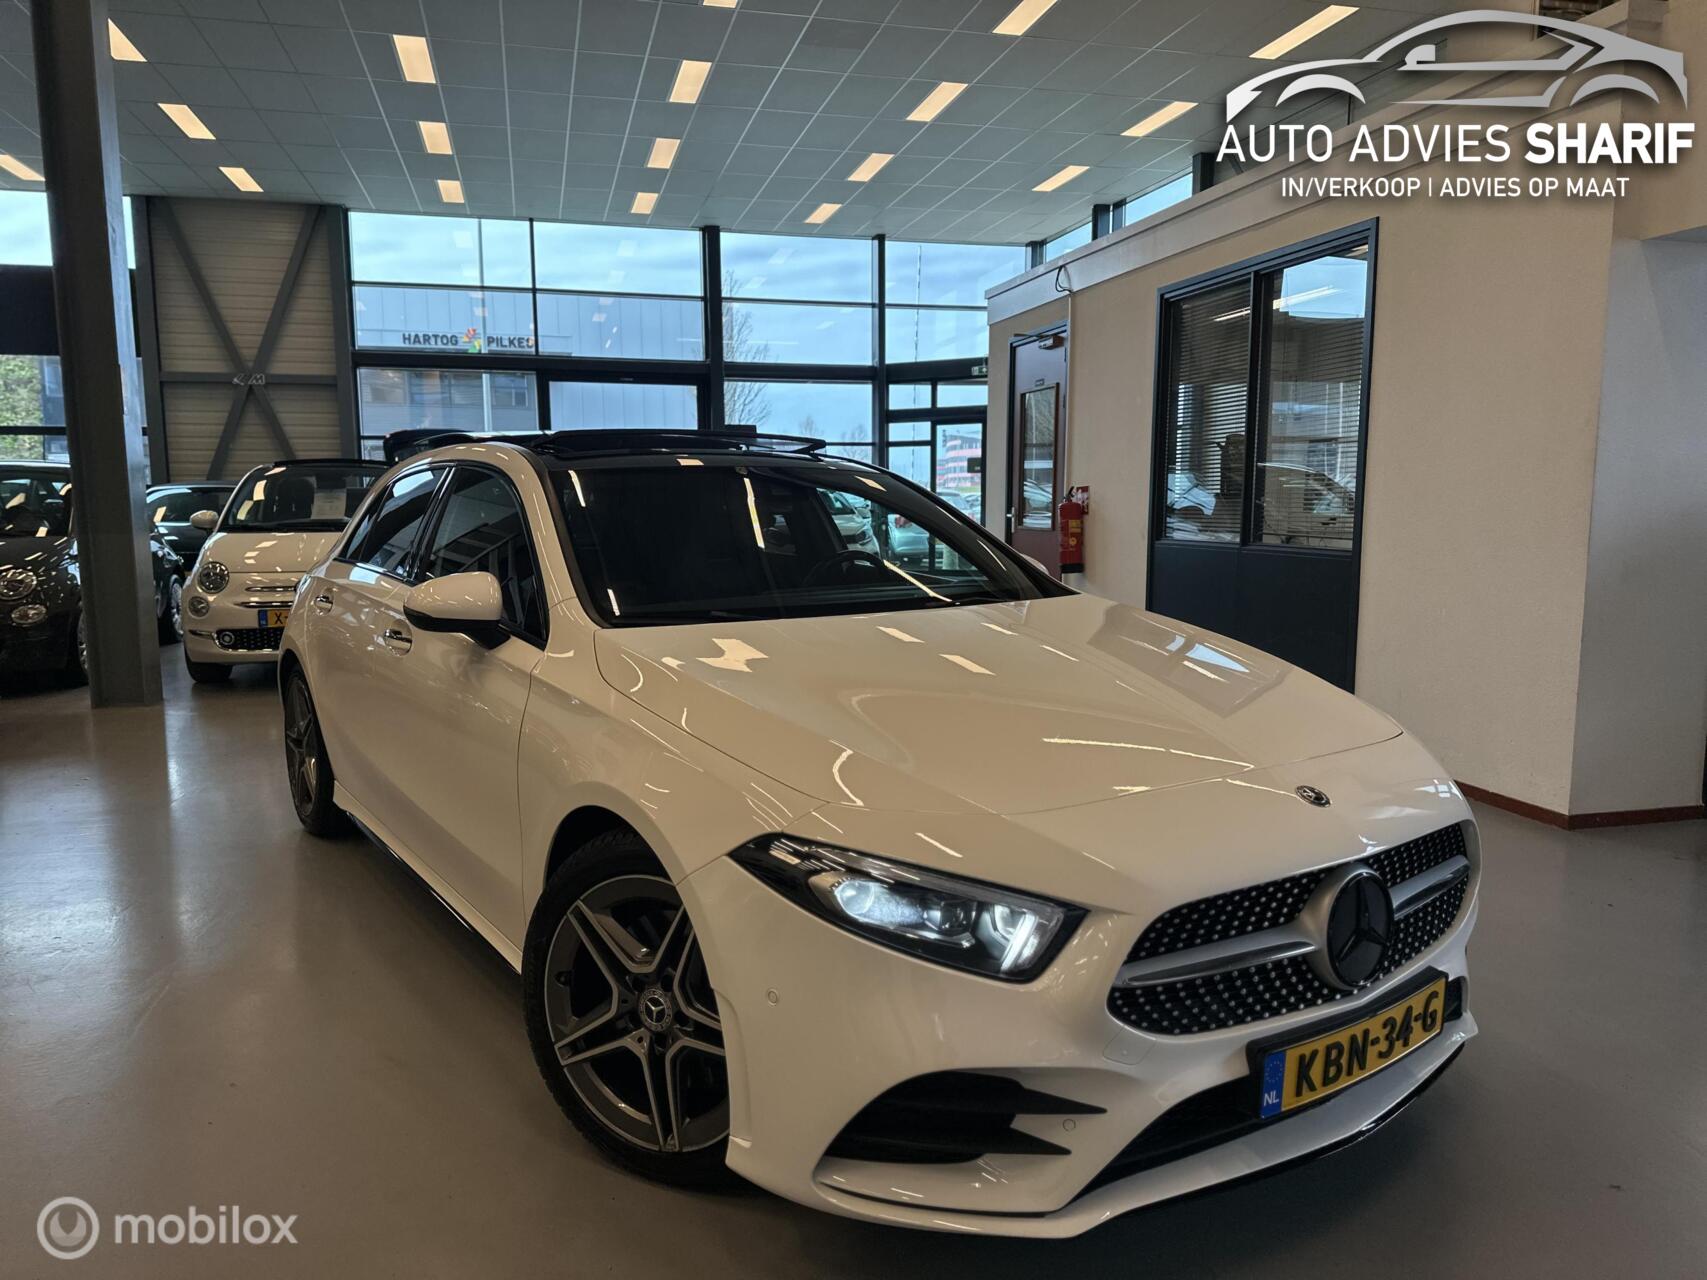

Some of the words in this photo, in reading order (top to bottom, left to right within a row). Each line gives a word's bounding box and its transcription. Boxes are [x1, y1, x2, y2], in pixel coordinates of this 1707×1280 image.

[402, 333, 459, 346] HARTOG
[1295, 990, 1440, 1098] KBN-34-G
[1263, 1090, 1280, 1107] NL
